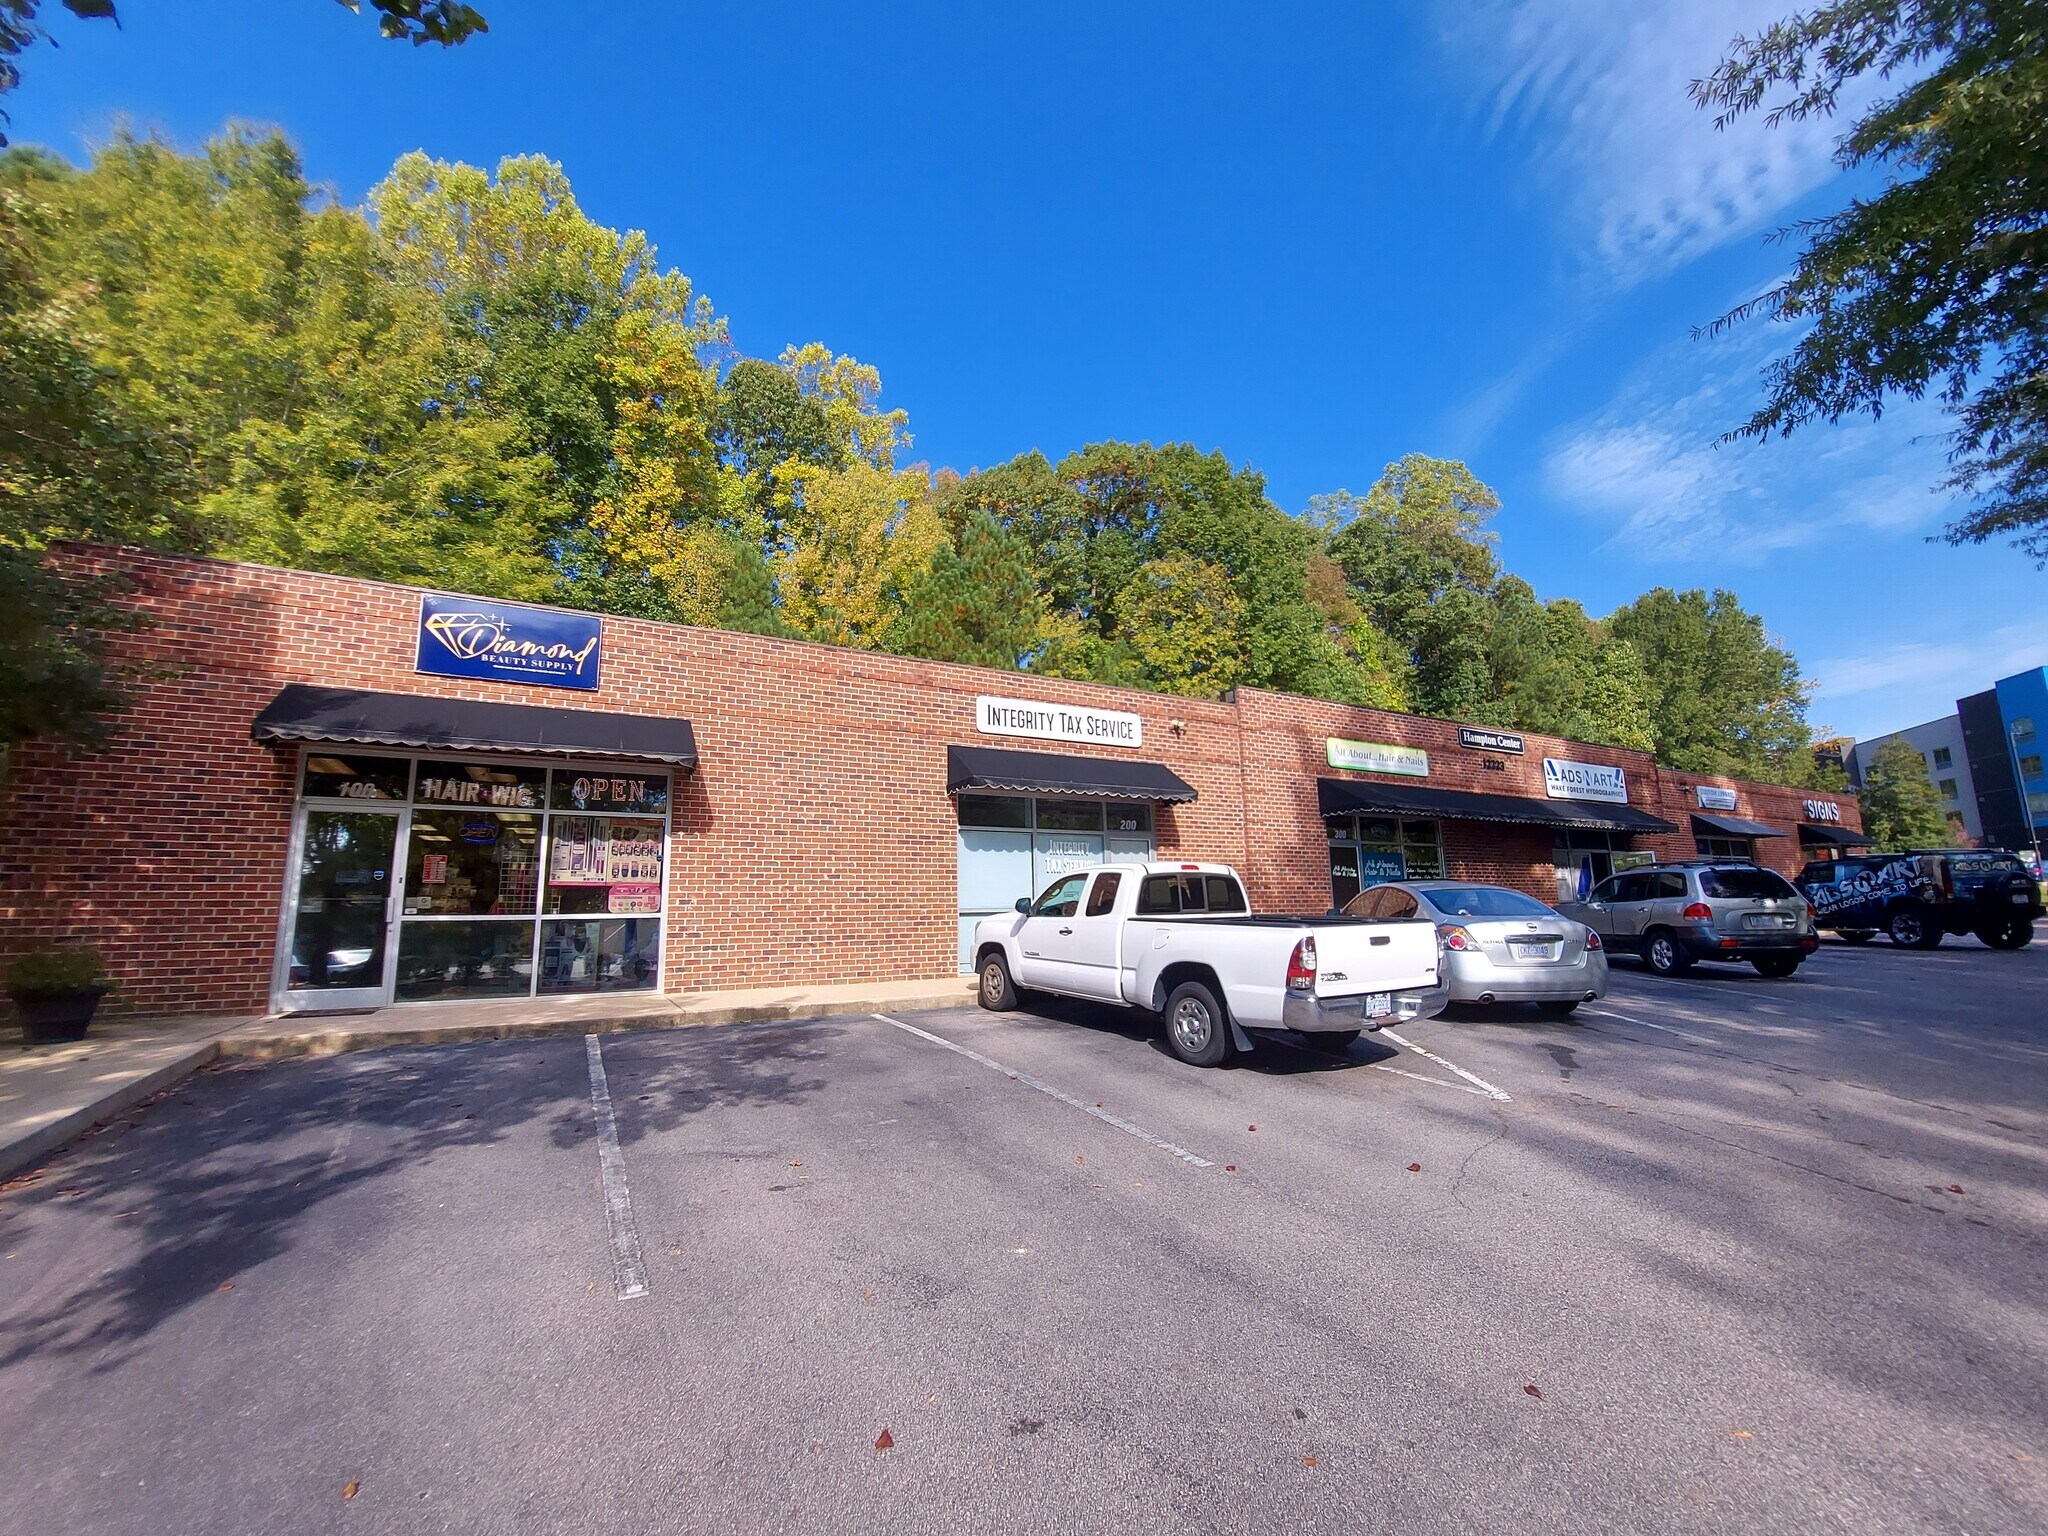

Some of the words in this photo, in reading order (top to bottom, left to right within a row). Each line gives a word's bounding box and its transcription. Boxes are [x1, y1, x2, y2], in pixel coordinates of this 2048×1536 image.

[457, 623, 598, 675] Diamond
[481, 654, 528, 667] BEAUTY
[531, 659, 575, 671] SUPPLY
[1463, 731, 1497, 746] Hampton
[1497, 735, 1521, 750] Center
[1334, 744, 1346, 757] All
[1379, 752, 1395, 763] Hair
[1405, 753, 1424, 766] Nails
[1561, 768, 1583, 784] ADS
[1593, 773, 1613, 788] ART
[339, 781, 376, 798] 100
[424, 778, 480, 803] HAIR
[573, 777, 646, 802] OPEN
[1551, 783, 1566, 792] WAKE
[1567, 786, 1585, 795] FOREST
[1586, 787, 1624, 798] HYDROGRAPHICS
[1808, 800, 1839, 821] SIGNS
[459, 827, 499, 838] OPEN
[1120, 820, 1137, 830] 200
[1334, 829, 1347, 839] 300
[1839, 895, 1866, 908] LOGOS
[1867, 889, 1892, 900] COME
[1894, 883, 1907, 892] TO
[1909, 876, 1932, 888] LIFE
